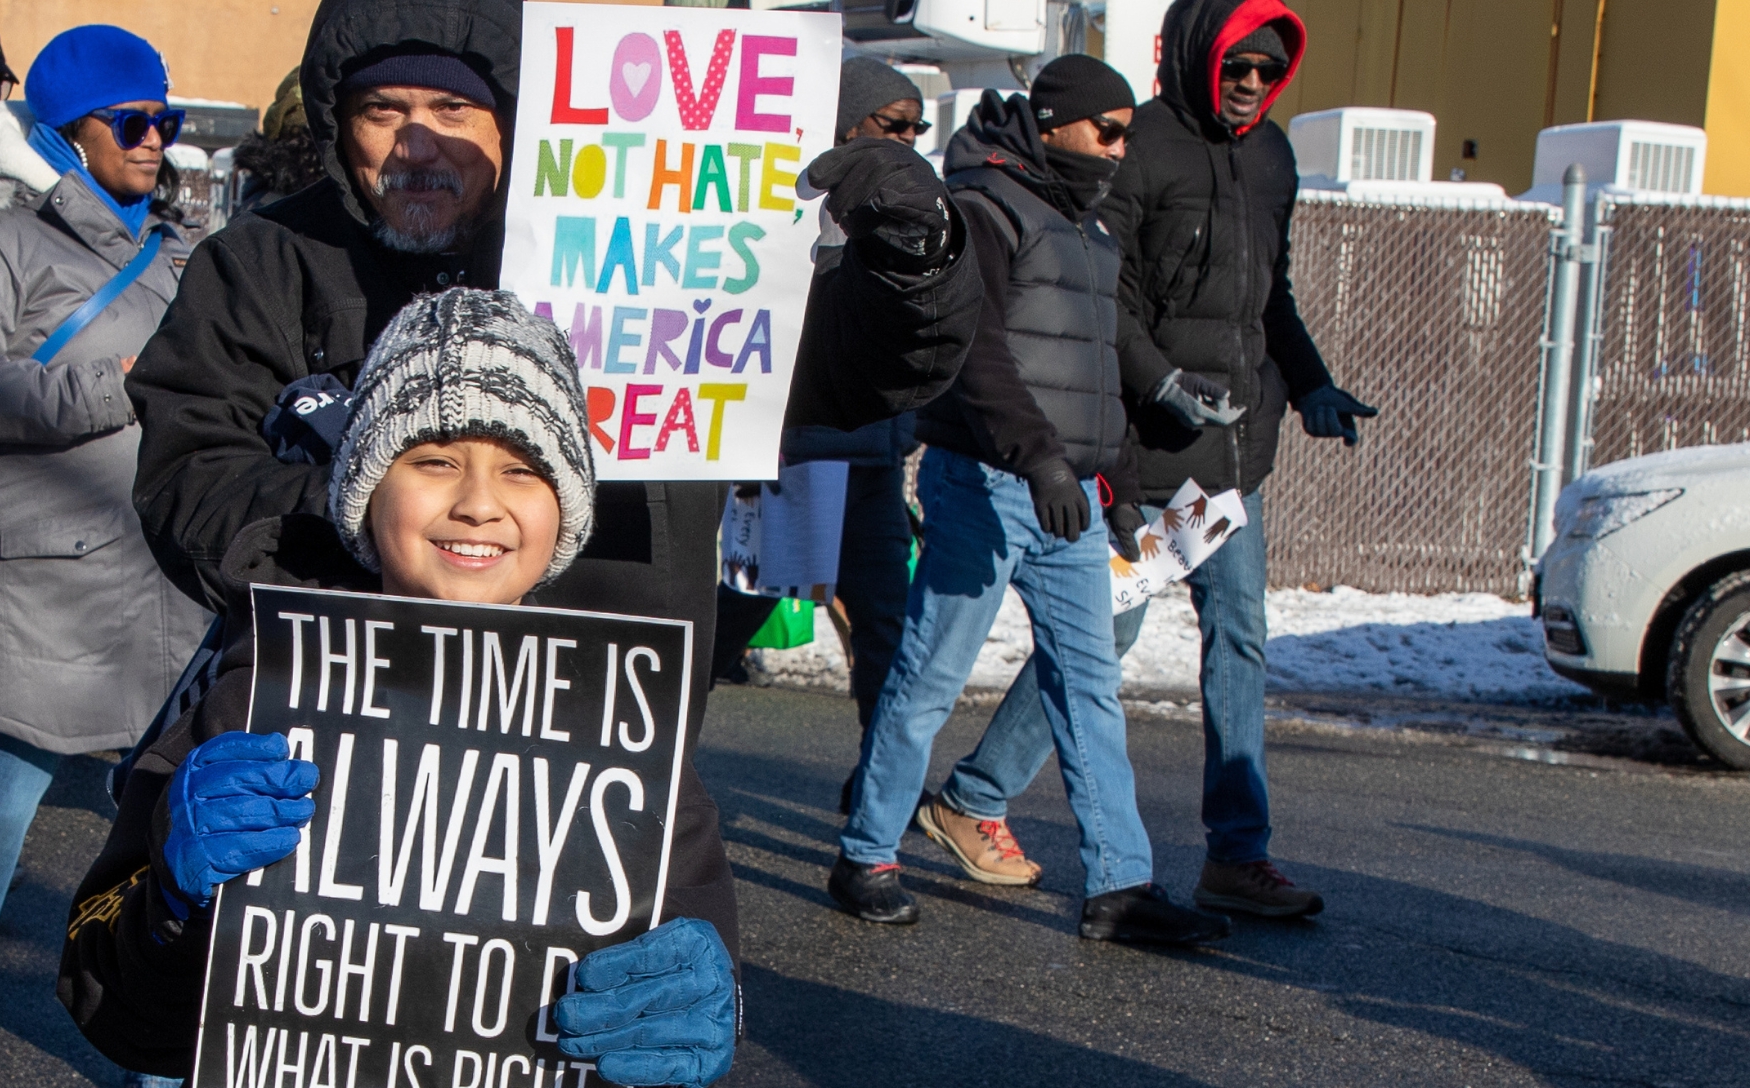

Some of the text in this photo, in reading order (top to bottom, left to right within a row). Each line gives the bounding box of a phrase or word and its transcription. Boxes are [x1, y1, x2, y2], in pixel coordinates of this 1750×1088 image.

[550, 26, 804, 144] LOVE,
[533, 131, 804, 226] NOT HATE,
[549, 215, 768, 296] MAKES
[586, 382, 749, 462] REAT
[277, 611, 662, 753] THE TIME IS
[233, 904, 579, 1043] RIGHT TO D
